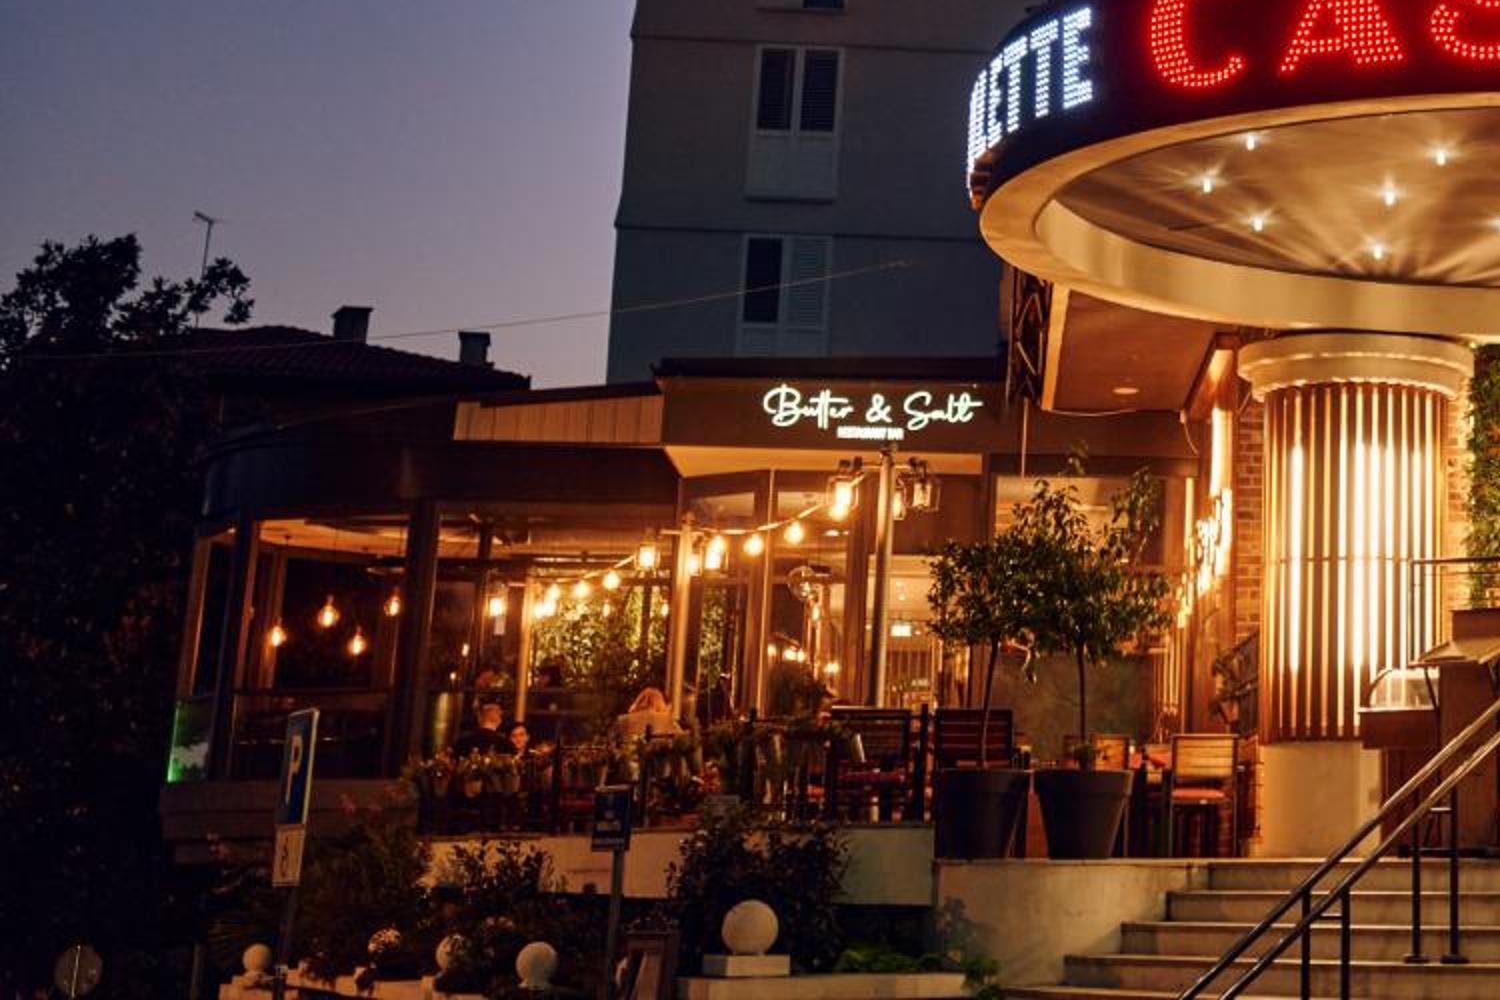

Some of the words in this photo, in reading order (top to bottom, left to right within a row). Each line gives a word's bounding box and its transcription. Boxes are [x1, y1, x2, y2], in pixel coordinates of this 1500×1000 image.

[762, 384, 854, 431] Butter
[865, 393, 893, 423] &
[903, 391, 984, 431] Salt
[285, 731, 304, 805] P
